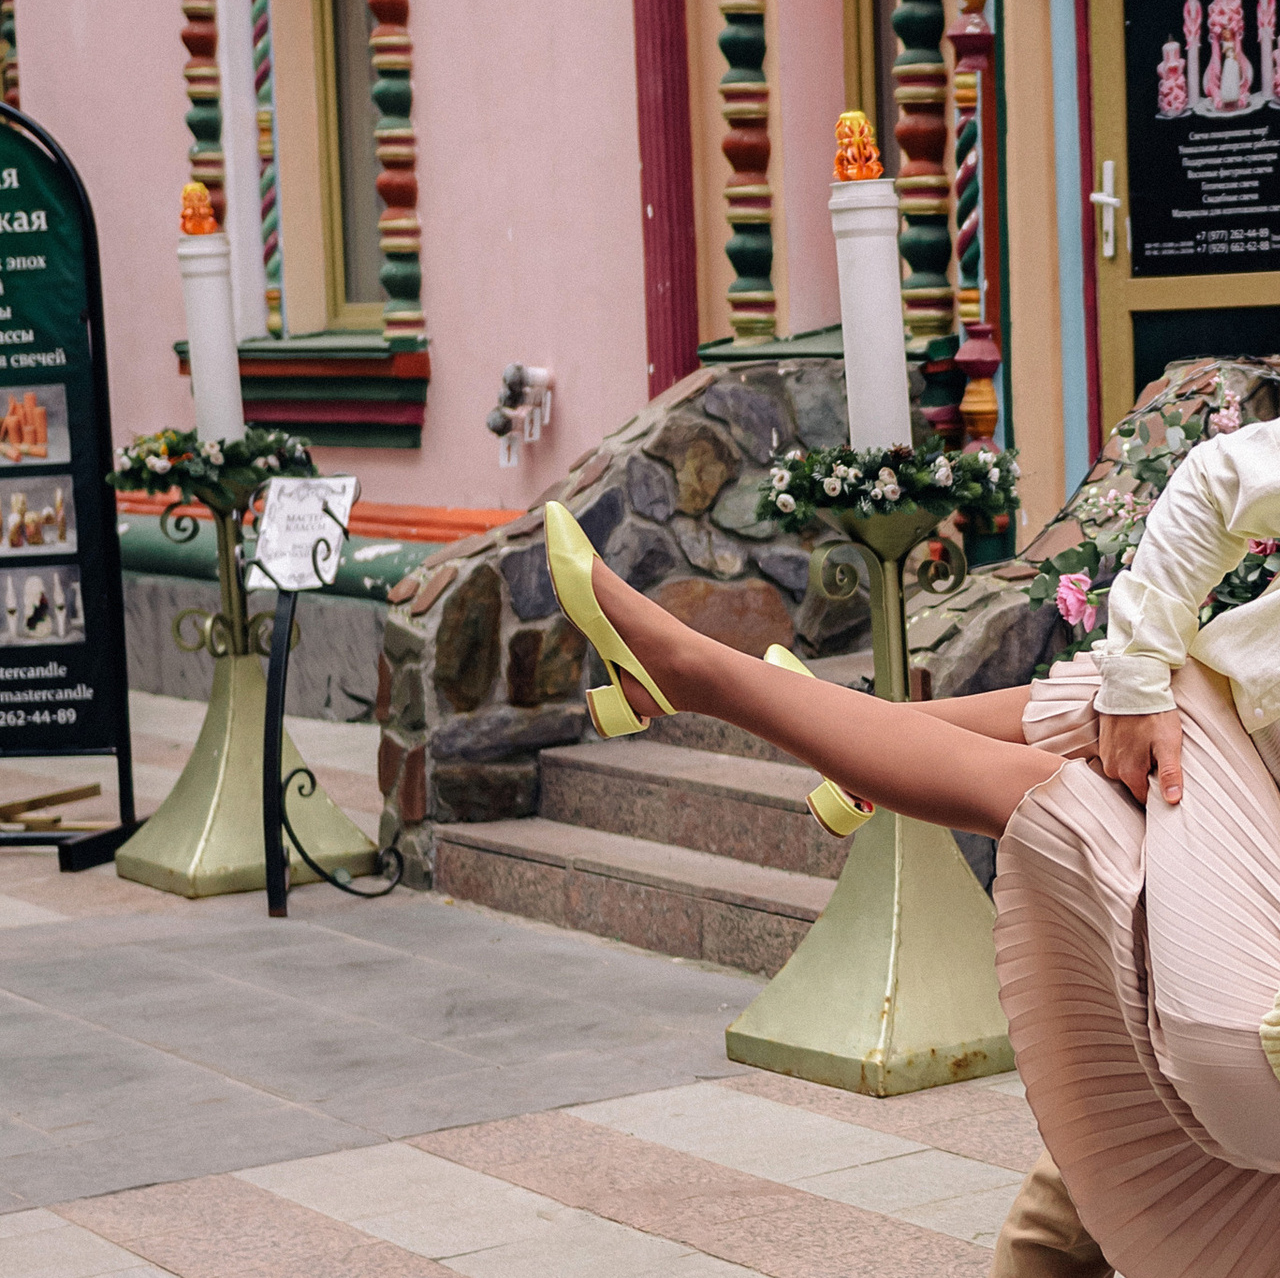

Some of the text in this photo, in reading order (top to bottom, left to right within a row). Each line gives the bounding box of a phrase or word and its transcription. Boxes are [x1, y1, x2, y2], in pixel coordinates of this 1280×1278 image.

[0, 167, 20, 190] я
[1218, 167, 1252, 179] фигурные
[1252, 165, 1274, 174] свечи
[1238, 179, 1260, 188] свечи
[1238, 192, 1259, 201] свечи
[1196, 231, 1206, 241] +7
[1207, 229, 1229, 241] (977)
[1230, 227, 1270, 239] 262-44-89
[1196, 243, 1207, 253] +7
[1208, 242, 1229, 255] (929)
[6, 254, 47, 272] эпох
[10, 347, 67, 369] свечей
